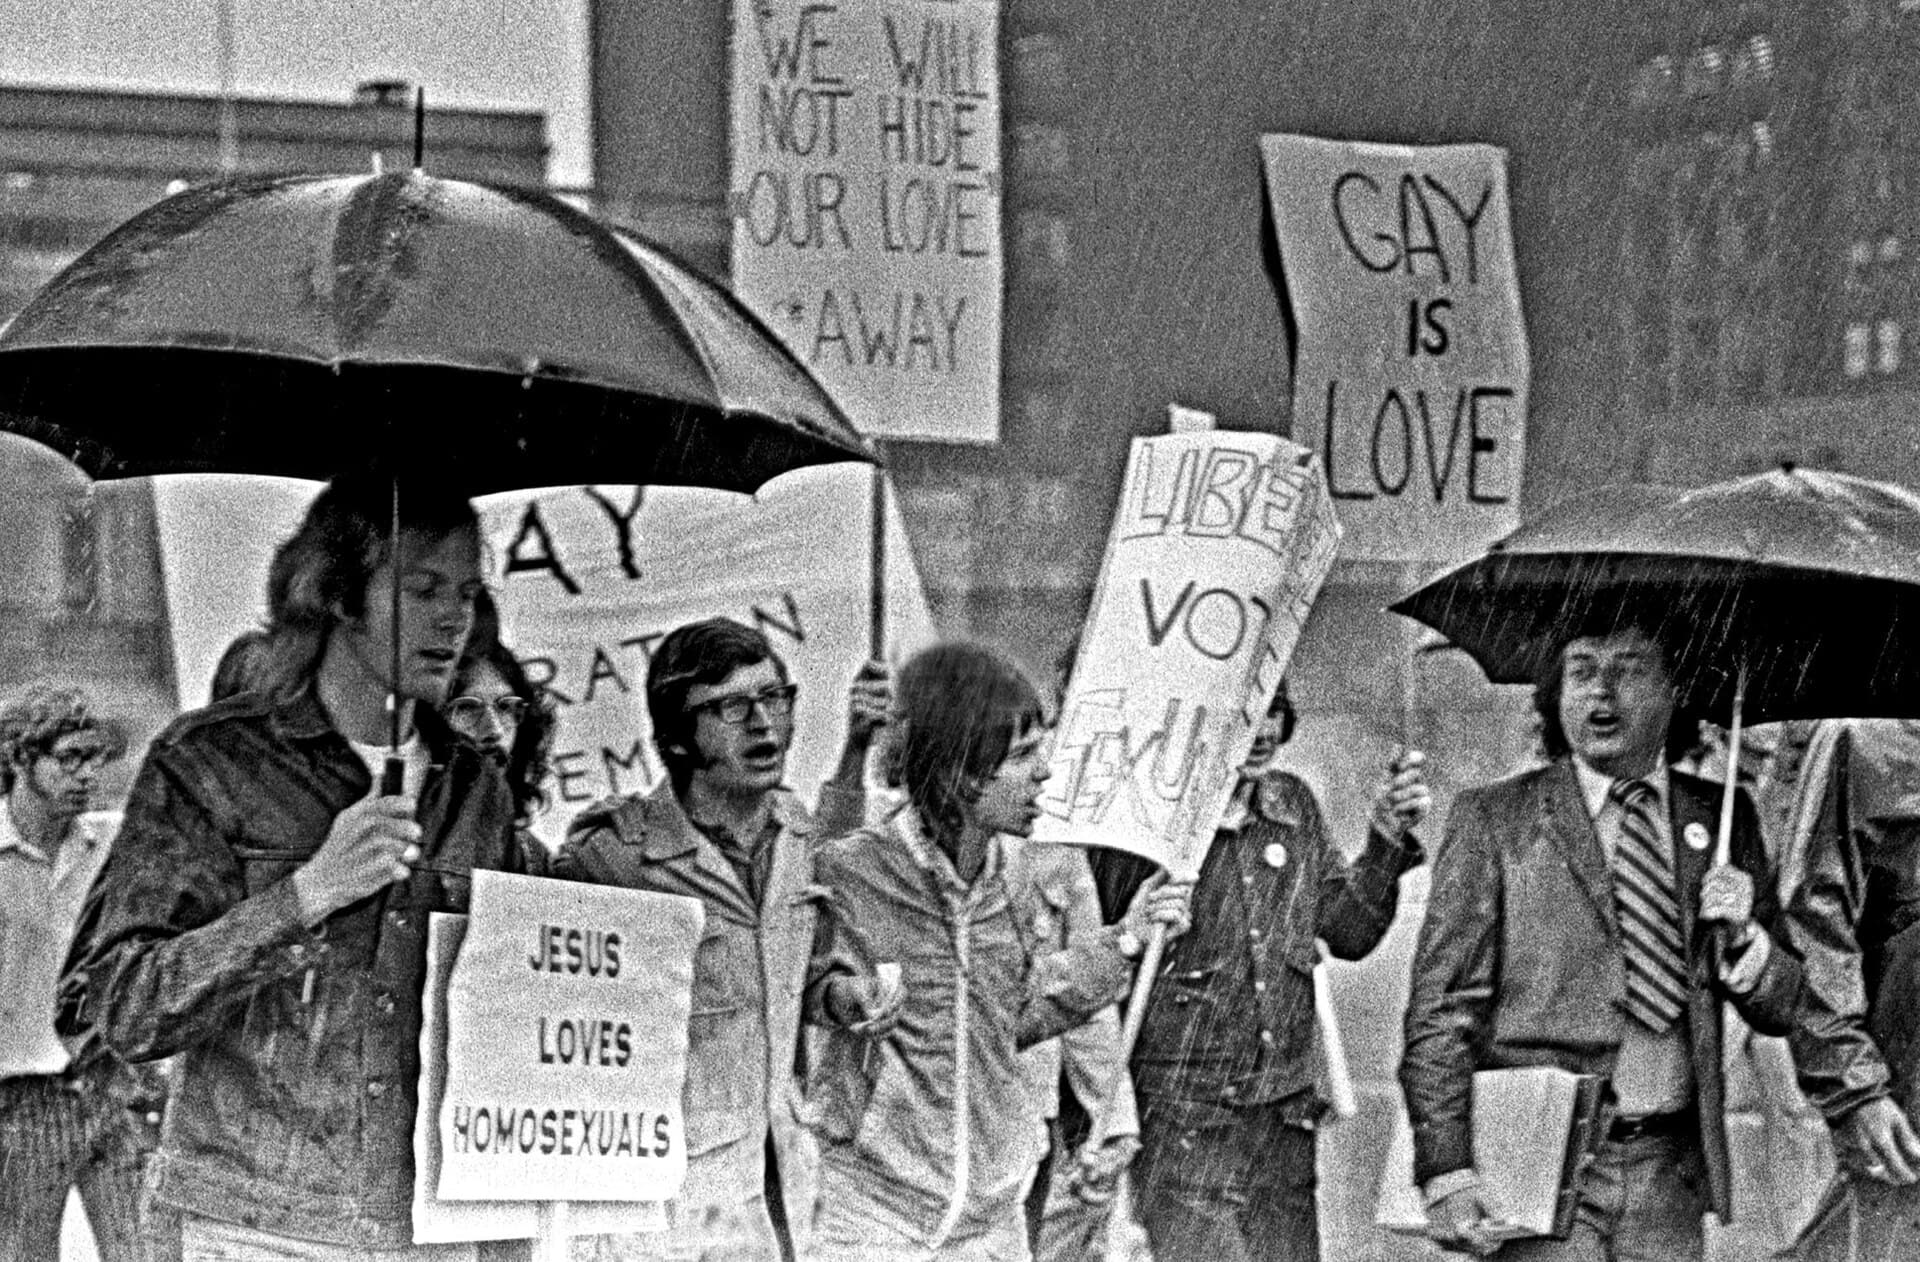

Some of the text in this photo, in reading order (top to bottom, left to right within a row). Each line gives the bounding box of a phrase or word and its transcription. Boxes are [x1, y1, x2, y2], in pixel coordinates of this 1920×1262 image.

[752, 3, 989, 98] WE WILL
[759, 83, 981, 173] NOT HIDE
[749, 170, 987, 257] OUR LOVE
[1332, 171, 1495, 284] GAY
[812, 290, 966, 372] AWAY
[1408, 299, 1452, 357] IS
[1324, 380, 1514, 502] LOVE
[502, 485, 643, 596] AY
[1120, 440, 1312, 558] LIBE
[530, 924, 622, 979] JESUS
[539, 1016, 632, 1067] LOVES
[452, 1104, 672, 1158] HOMOSEXUALS
